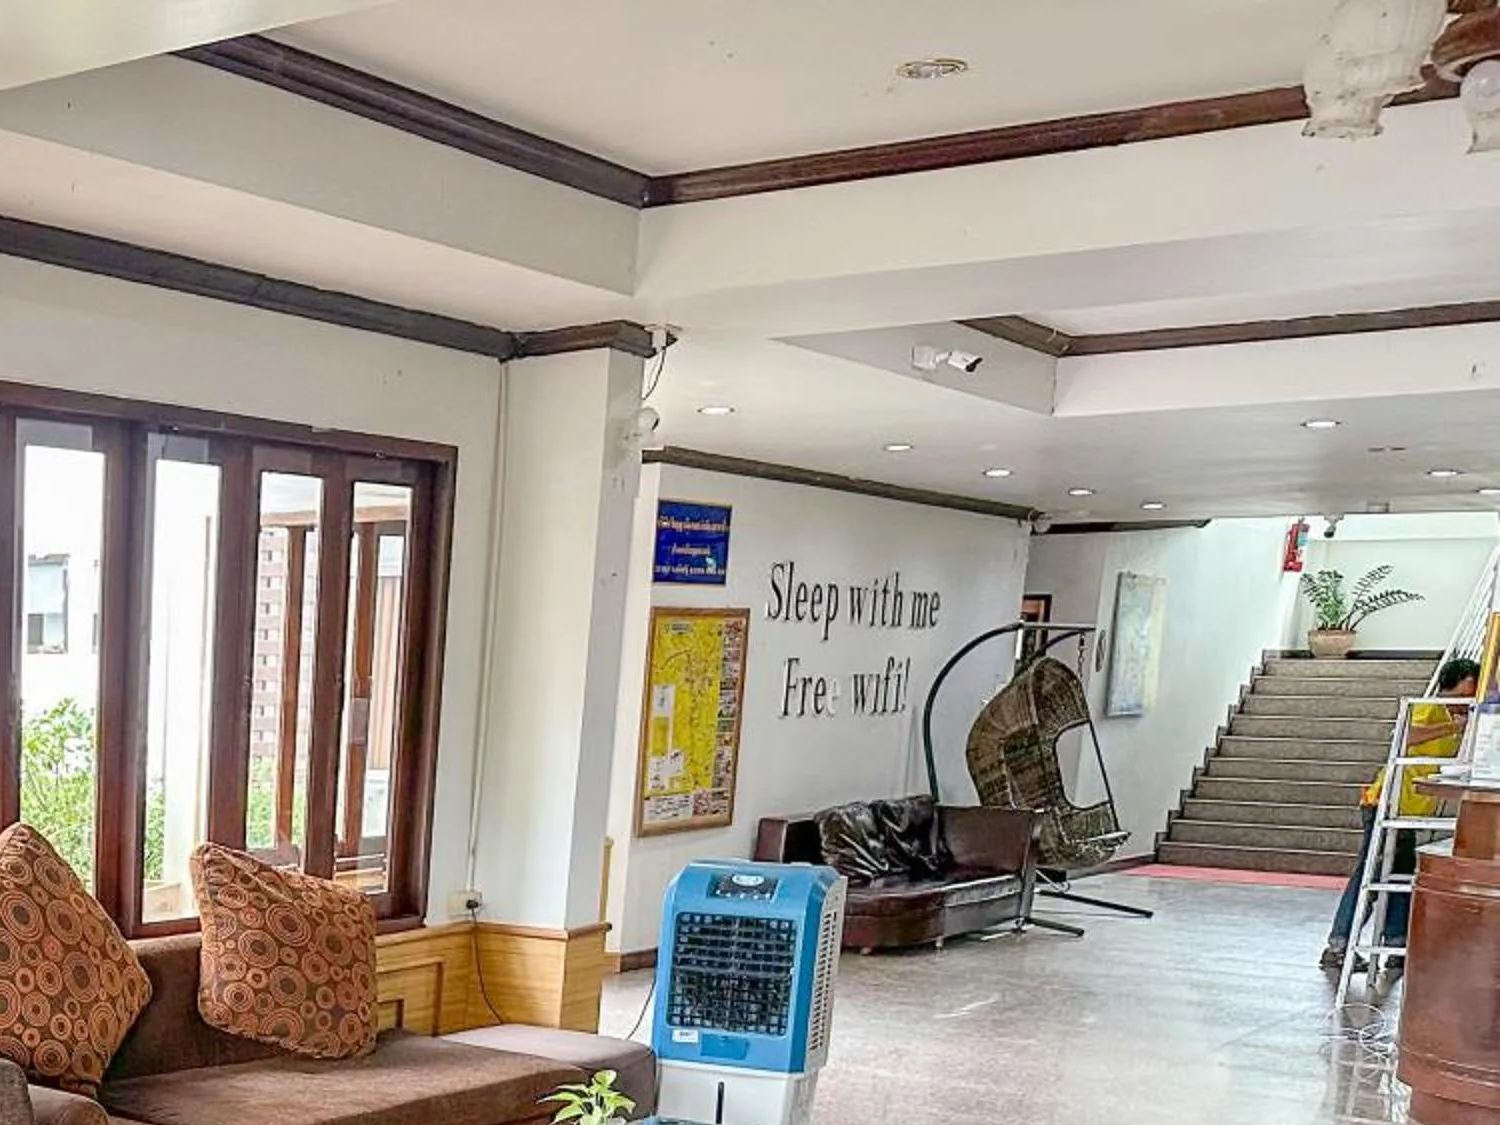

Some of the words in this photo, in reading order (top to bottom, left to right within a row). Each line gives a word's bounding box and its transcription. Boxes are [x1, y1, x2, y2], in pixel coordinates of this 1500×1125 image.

[766, 560, 840, 642] Sleep
[849, 571, 904, 628] with
[908, 589, 941, 629] me
